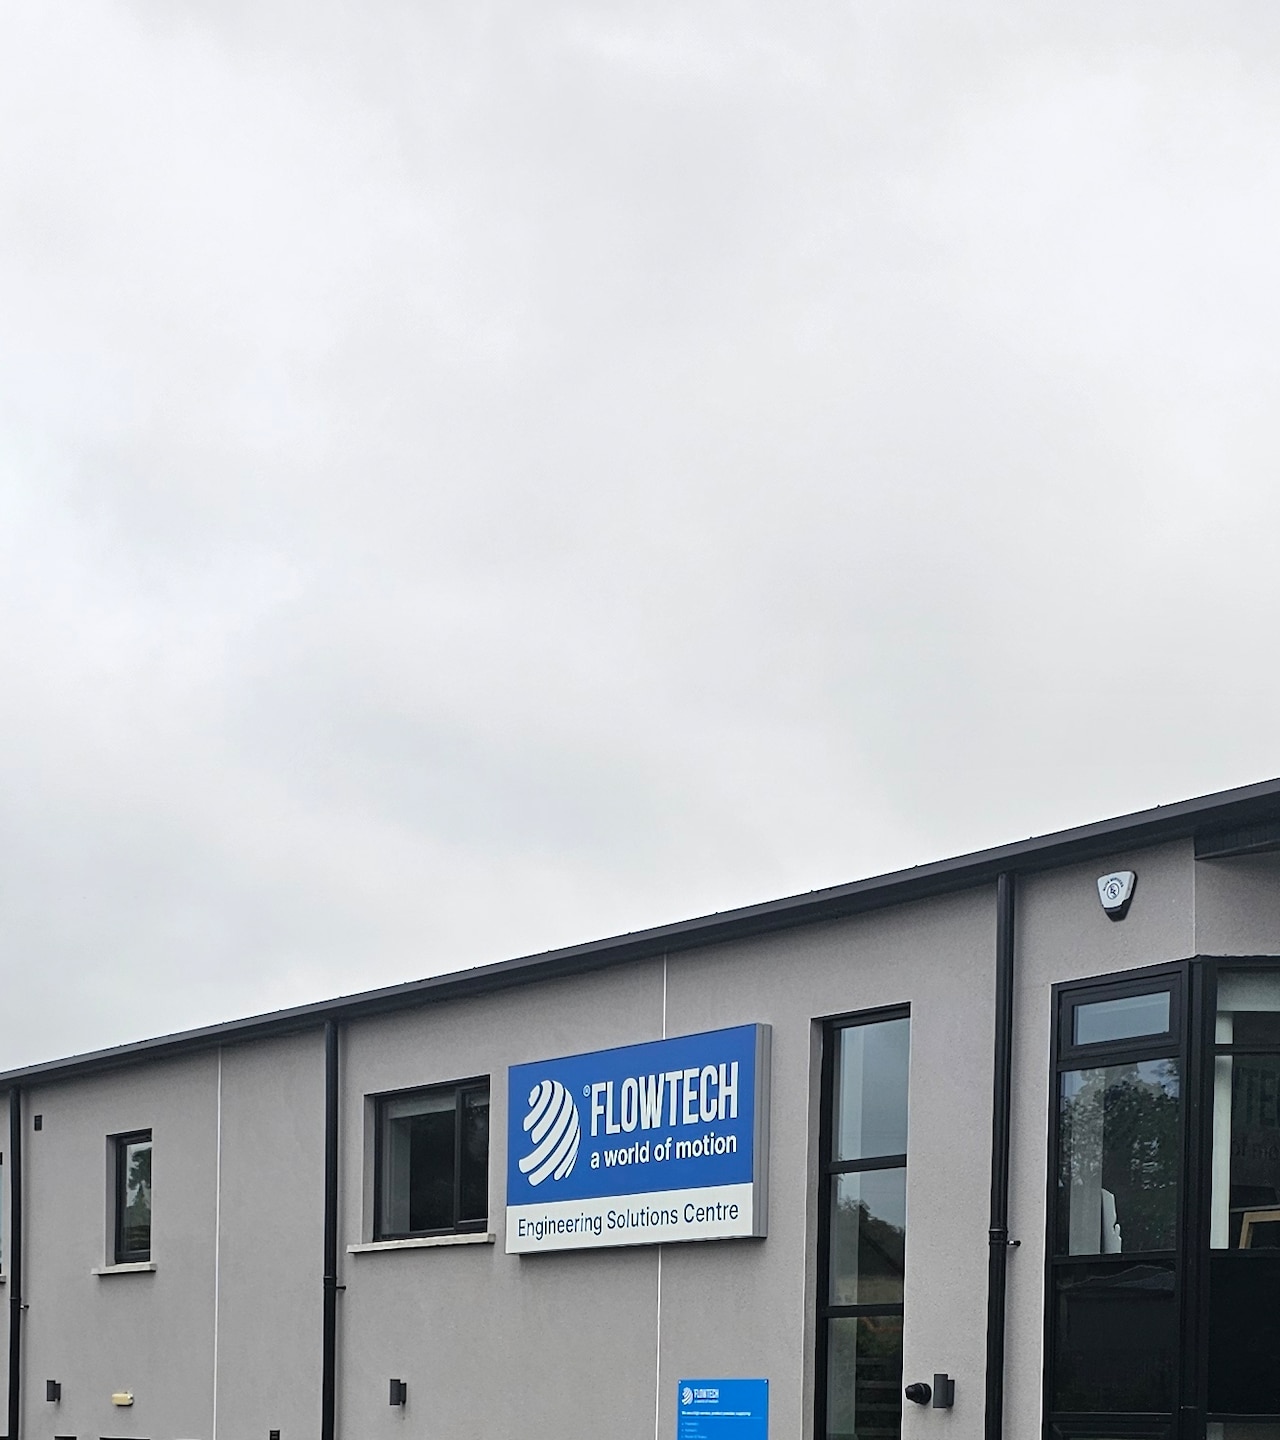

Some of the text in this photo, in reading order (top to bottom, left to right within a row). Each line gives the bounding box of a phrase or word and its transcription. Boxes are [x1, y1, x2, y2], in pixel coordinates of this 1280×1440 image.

[590, 1061, 739, 1137] FLOWTECH
[590, 1132, 737, 1169] a world of motion
[518, 1202, 739, 1241] Engineering Solutions Centre
